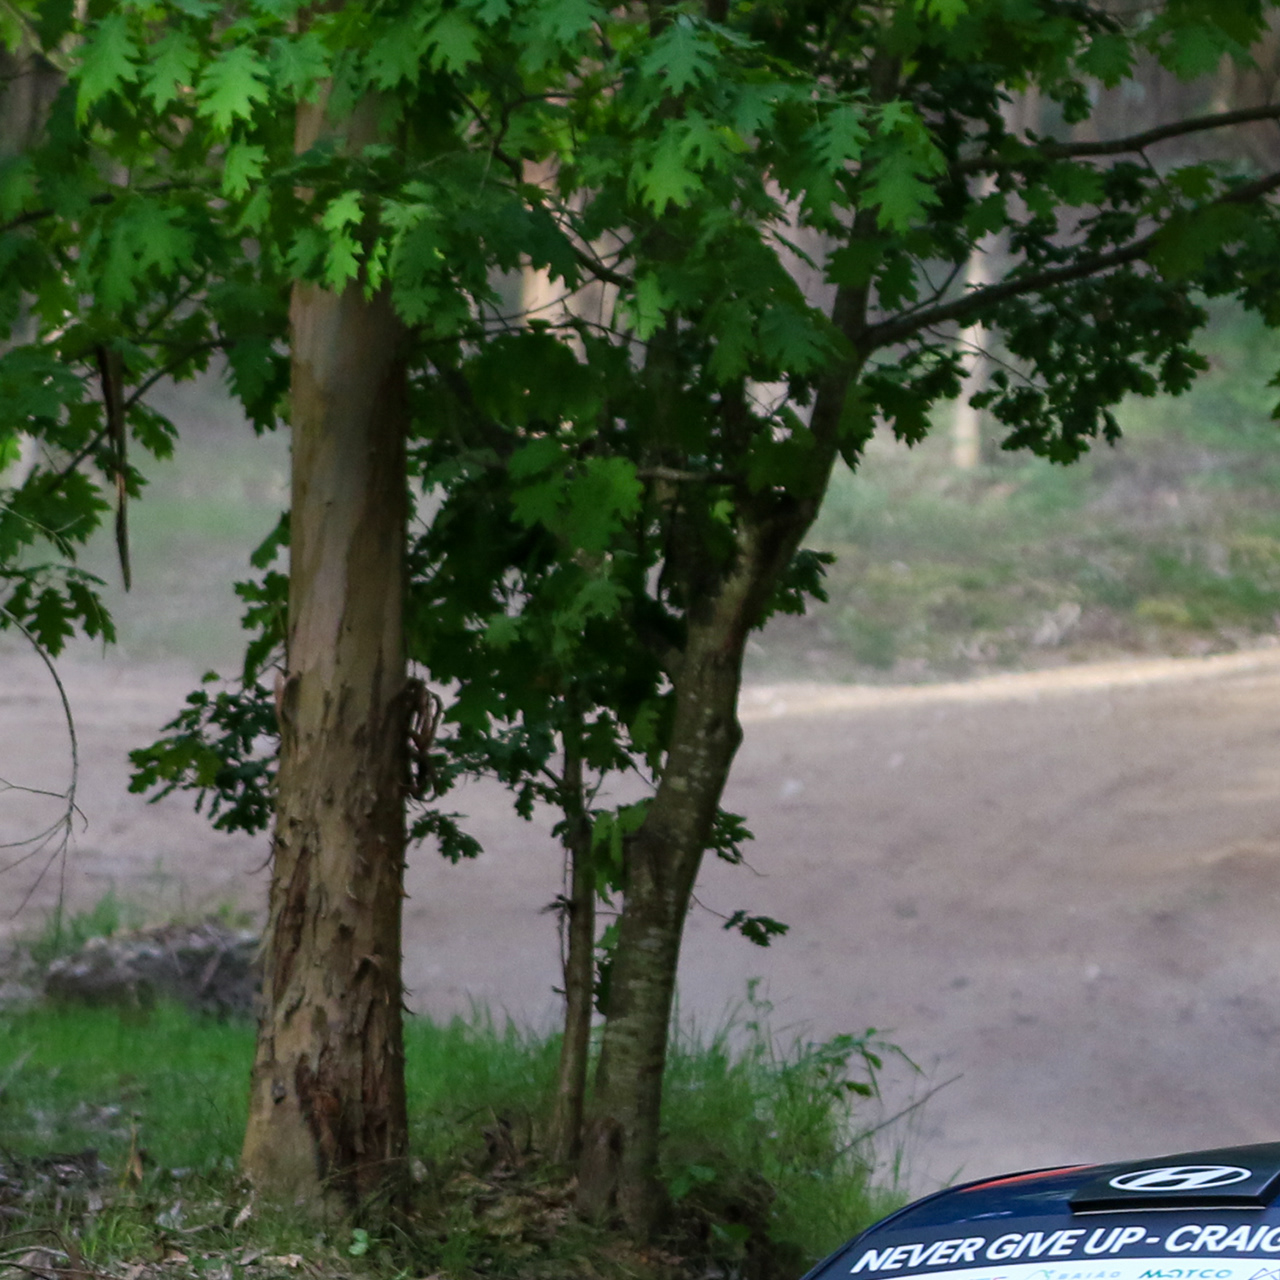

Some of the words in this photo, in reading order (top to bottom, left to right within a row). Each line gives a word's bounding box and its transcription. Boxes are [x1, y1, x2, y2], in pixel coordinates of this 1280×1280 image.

[850, 1236, 986, 1275] NEVER
[985, 1227, 1087, 1261] GIVE
[1083, 1225, 1148, 1256] UP
